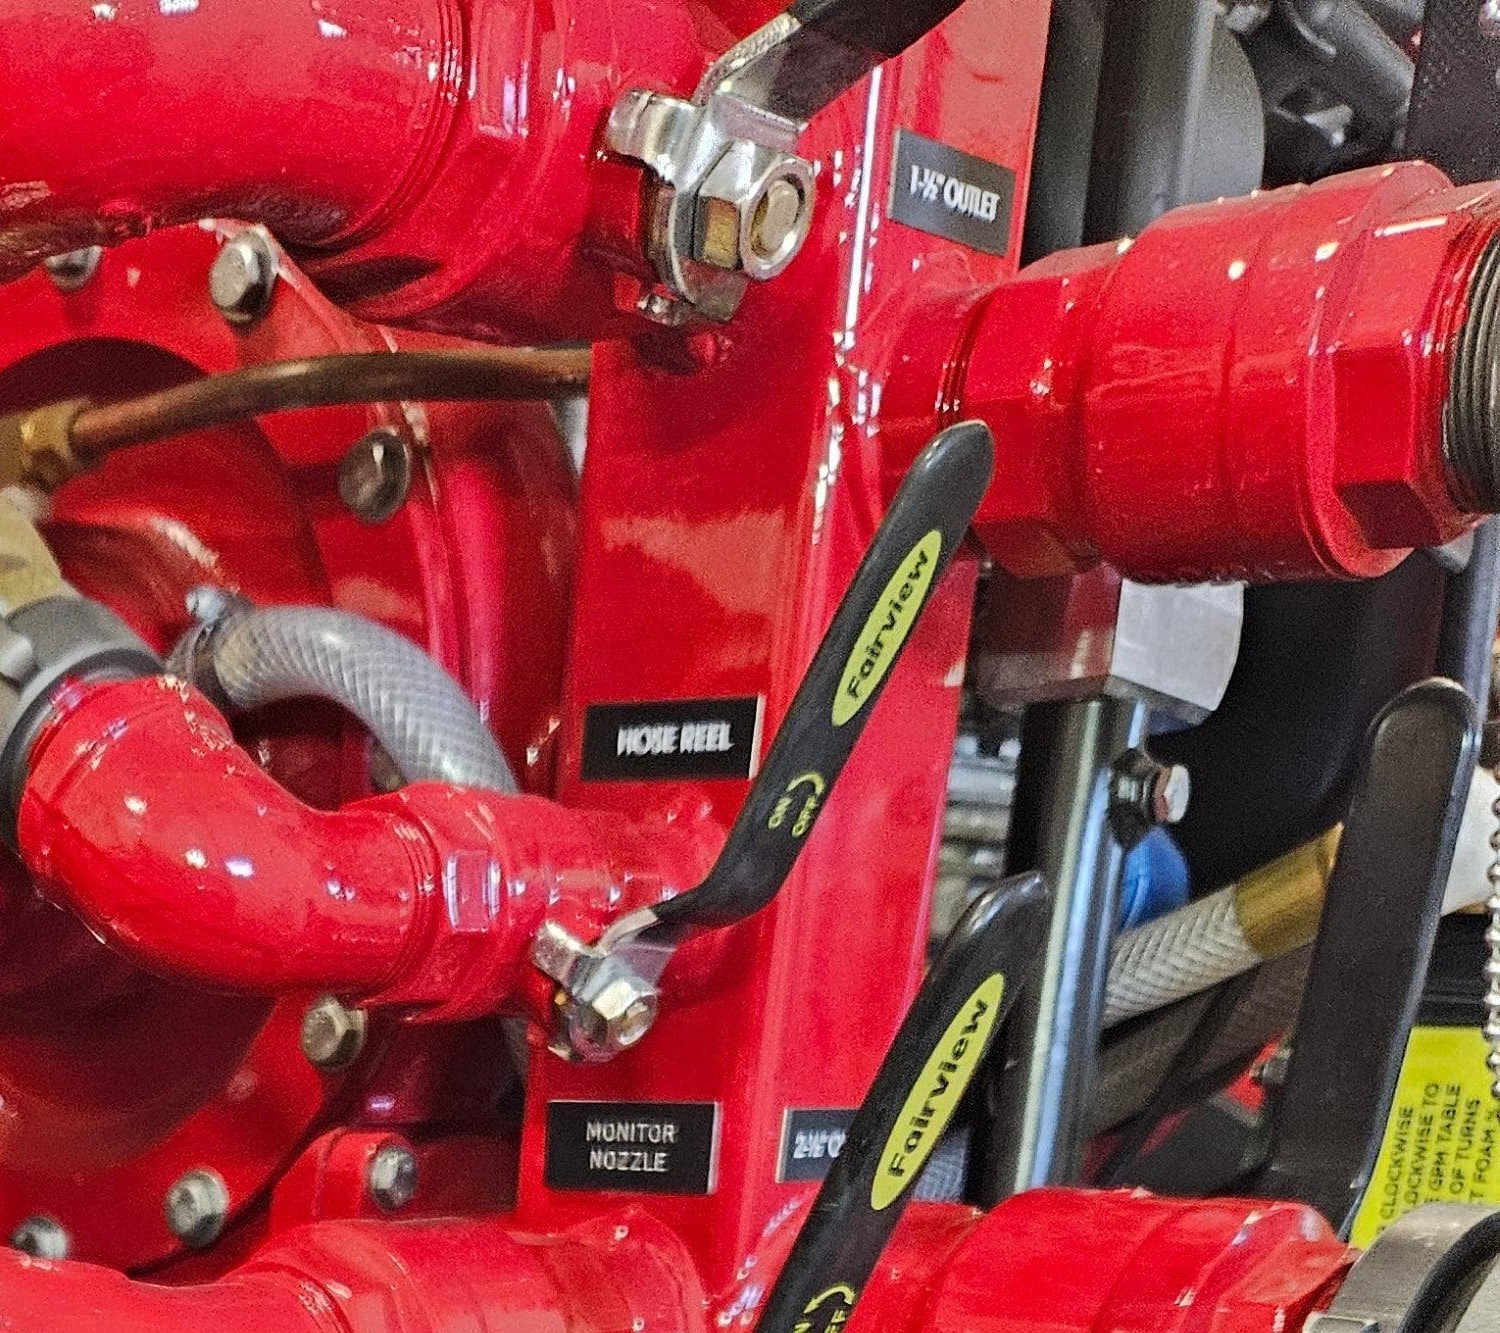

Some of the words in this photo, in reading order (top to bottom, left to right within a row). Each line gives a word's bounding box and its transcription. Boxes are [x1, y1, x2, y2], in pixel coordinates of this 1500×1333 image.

[943, 177, 1000, 222] OUTLET
[847, 550, 929, 698] Fairview
[617, 724, 679, 757] HOSE
[680, 720, 735, 753] REEL
[768, 797, 792, 830] ON
[792, 795, 819, 838] OFF
[887, 999, 989, 1178] Fairview
[1422, 1082, 1440, 1106] TO
[586, 1120, 678, 1143] MONITOR
[1437, 1083, 1460, 1143] TABLE
[1455, 1098, 1481, 1161] TURNS
[589, 1150, 669, 1173] NOZZLE
[1380, 1105, 1413, 1219] CLOCKWISE
[1428, 1151, 1448, 1191] GPM
[1473, 1129, 1495, 1183] FOAM
[1449, 1167, 1465, 1195] OF
